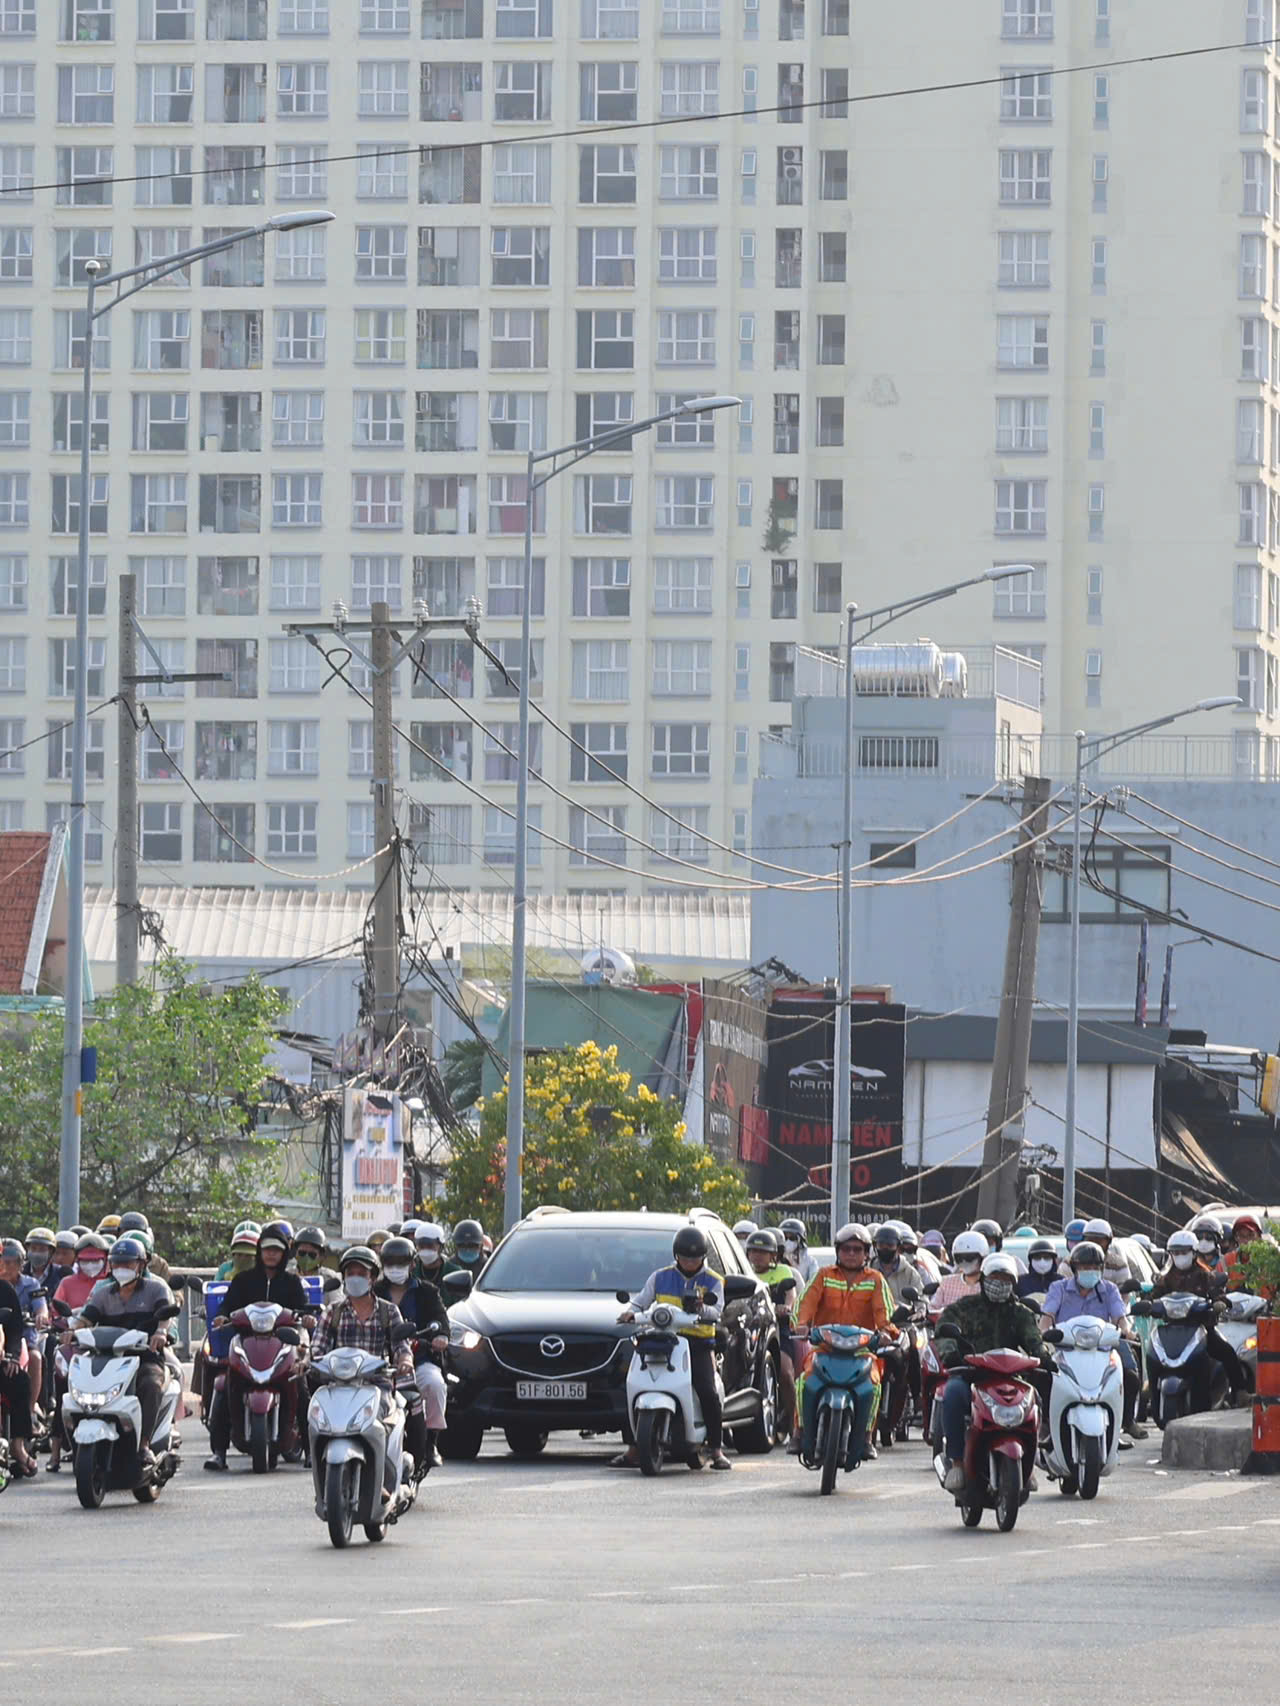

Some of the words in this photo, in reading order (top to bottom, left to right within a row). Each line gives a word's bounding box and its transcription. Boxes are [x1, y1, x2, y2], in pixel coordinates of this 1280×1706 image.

[789, 1079, 879, 1092] NAMEN
[850, 1114, 892, 1147] IẾN
[808, 1164, 872, 1188] AUO
[519, 1383, 585, 1398] 51F-801.56
